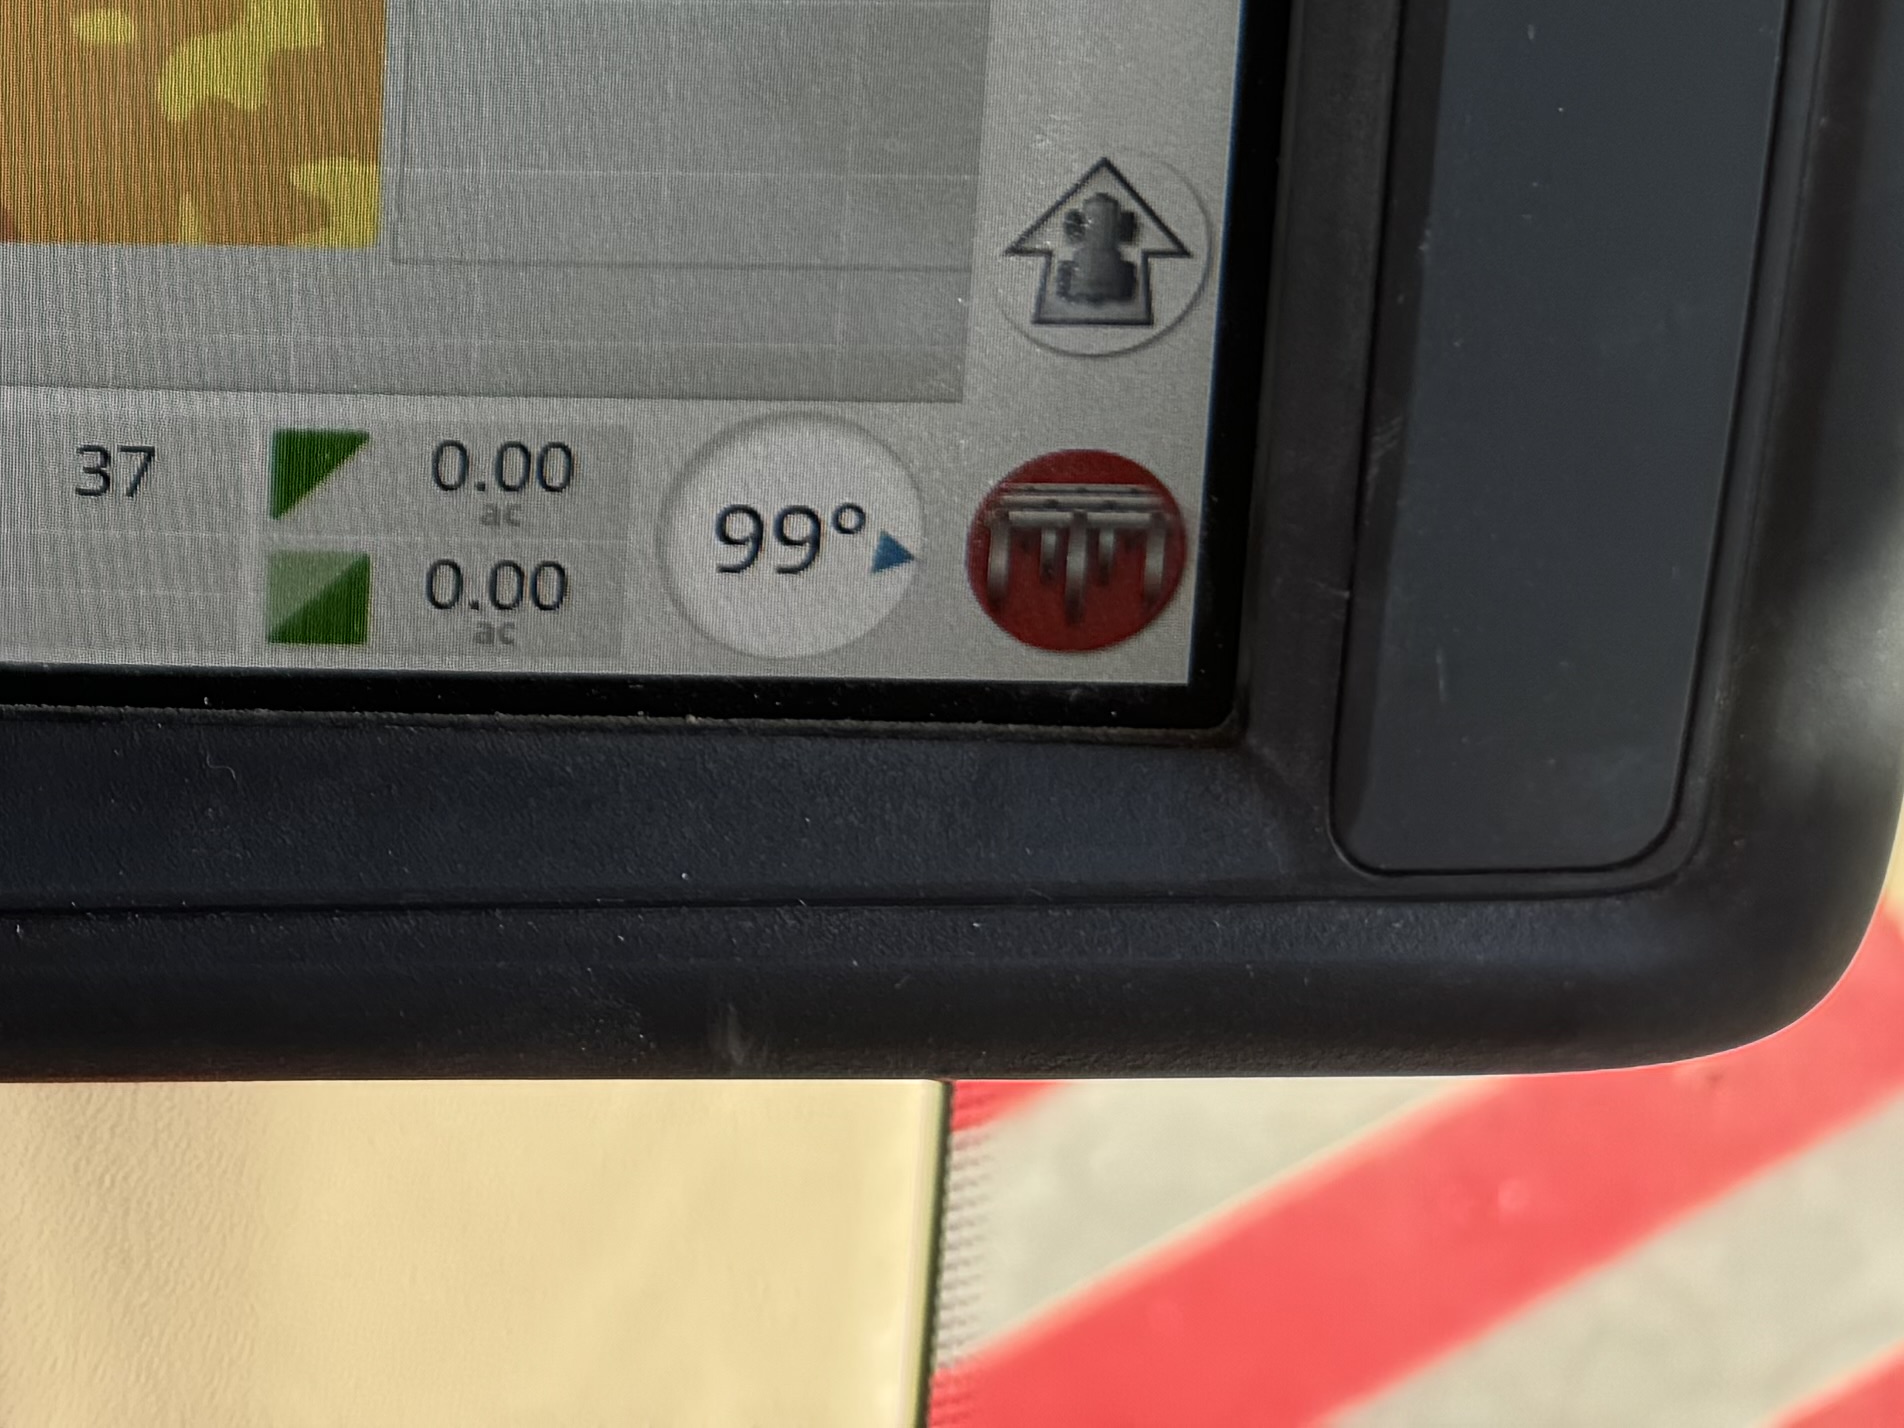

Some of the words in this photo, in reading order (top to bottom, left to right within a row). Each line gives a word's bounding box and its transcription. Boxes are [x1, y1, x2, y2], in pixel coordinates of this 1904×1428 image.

[75, 445, 156, 499] 37
[432, 440, 575, 495] 0.00
[481, 500, 521, 528] ac
[714, 502, 866, 575] 99°
[426, 558, 568, 612] 0.00
[474, 619, 516, 648] ac
